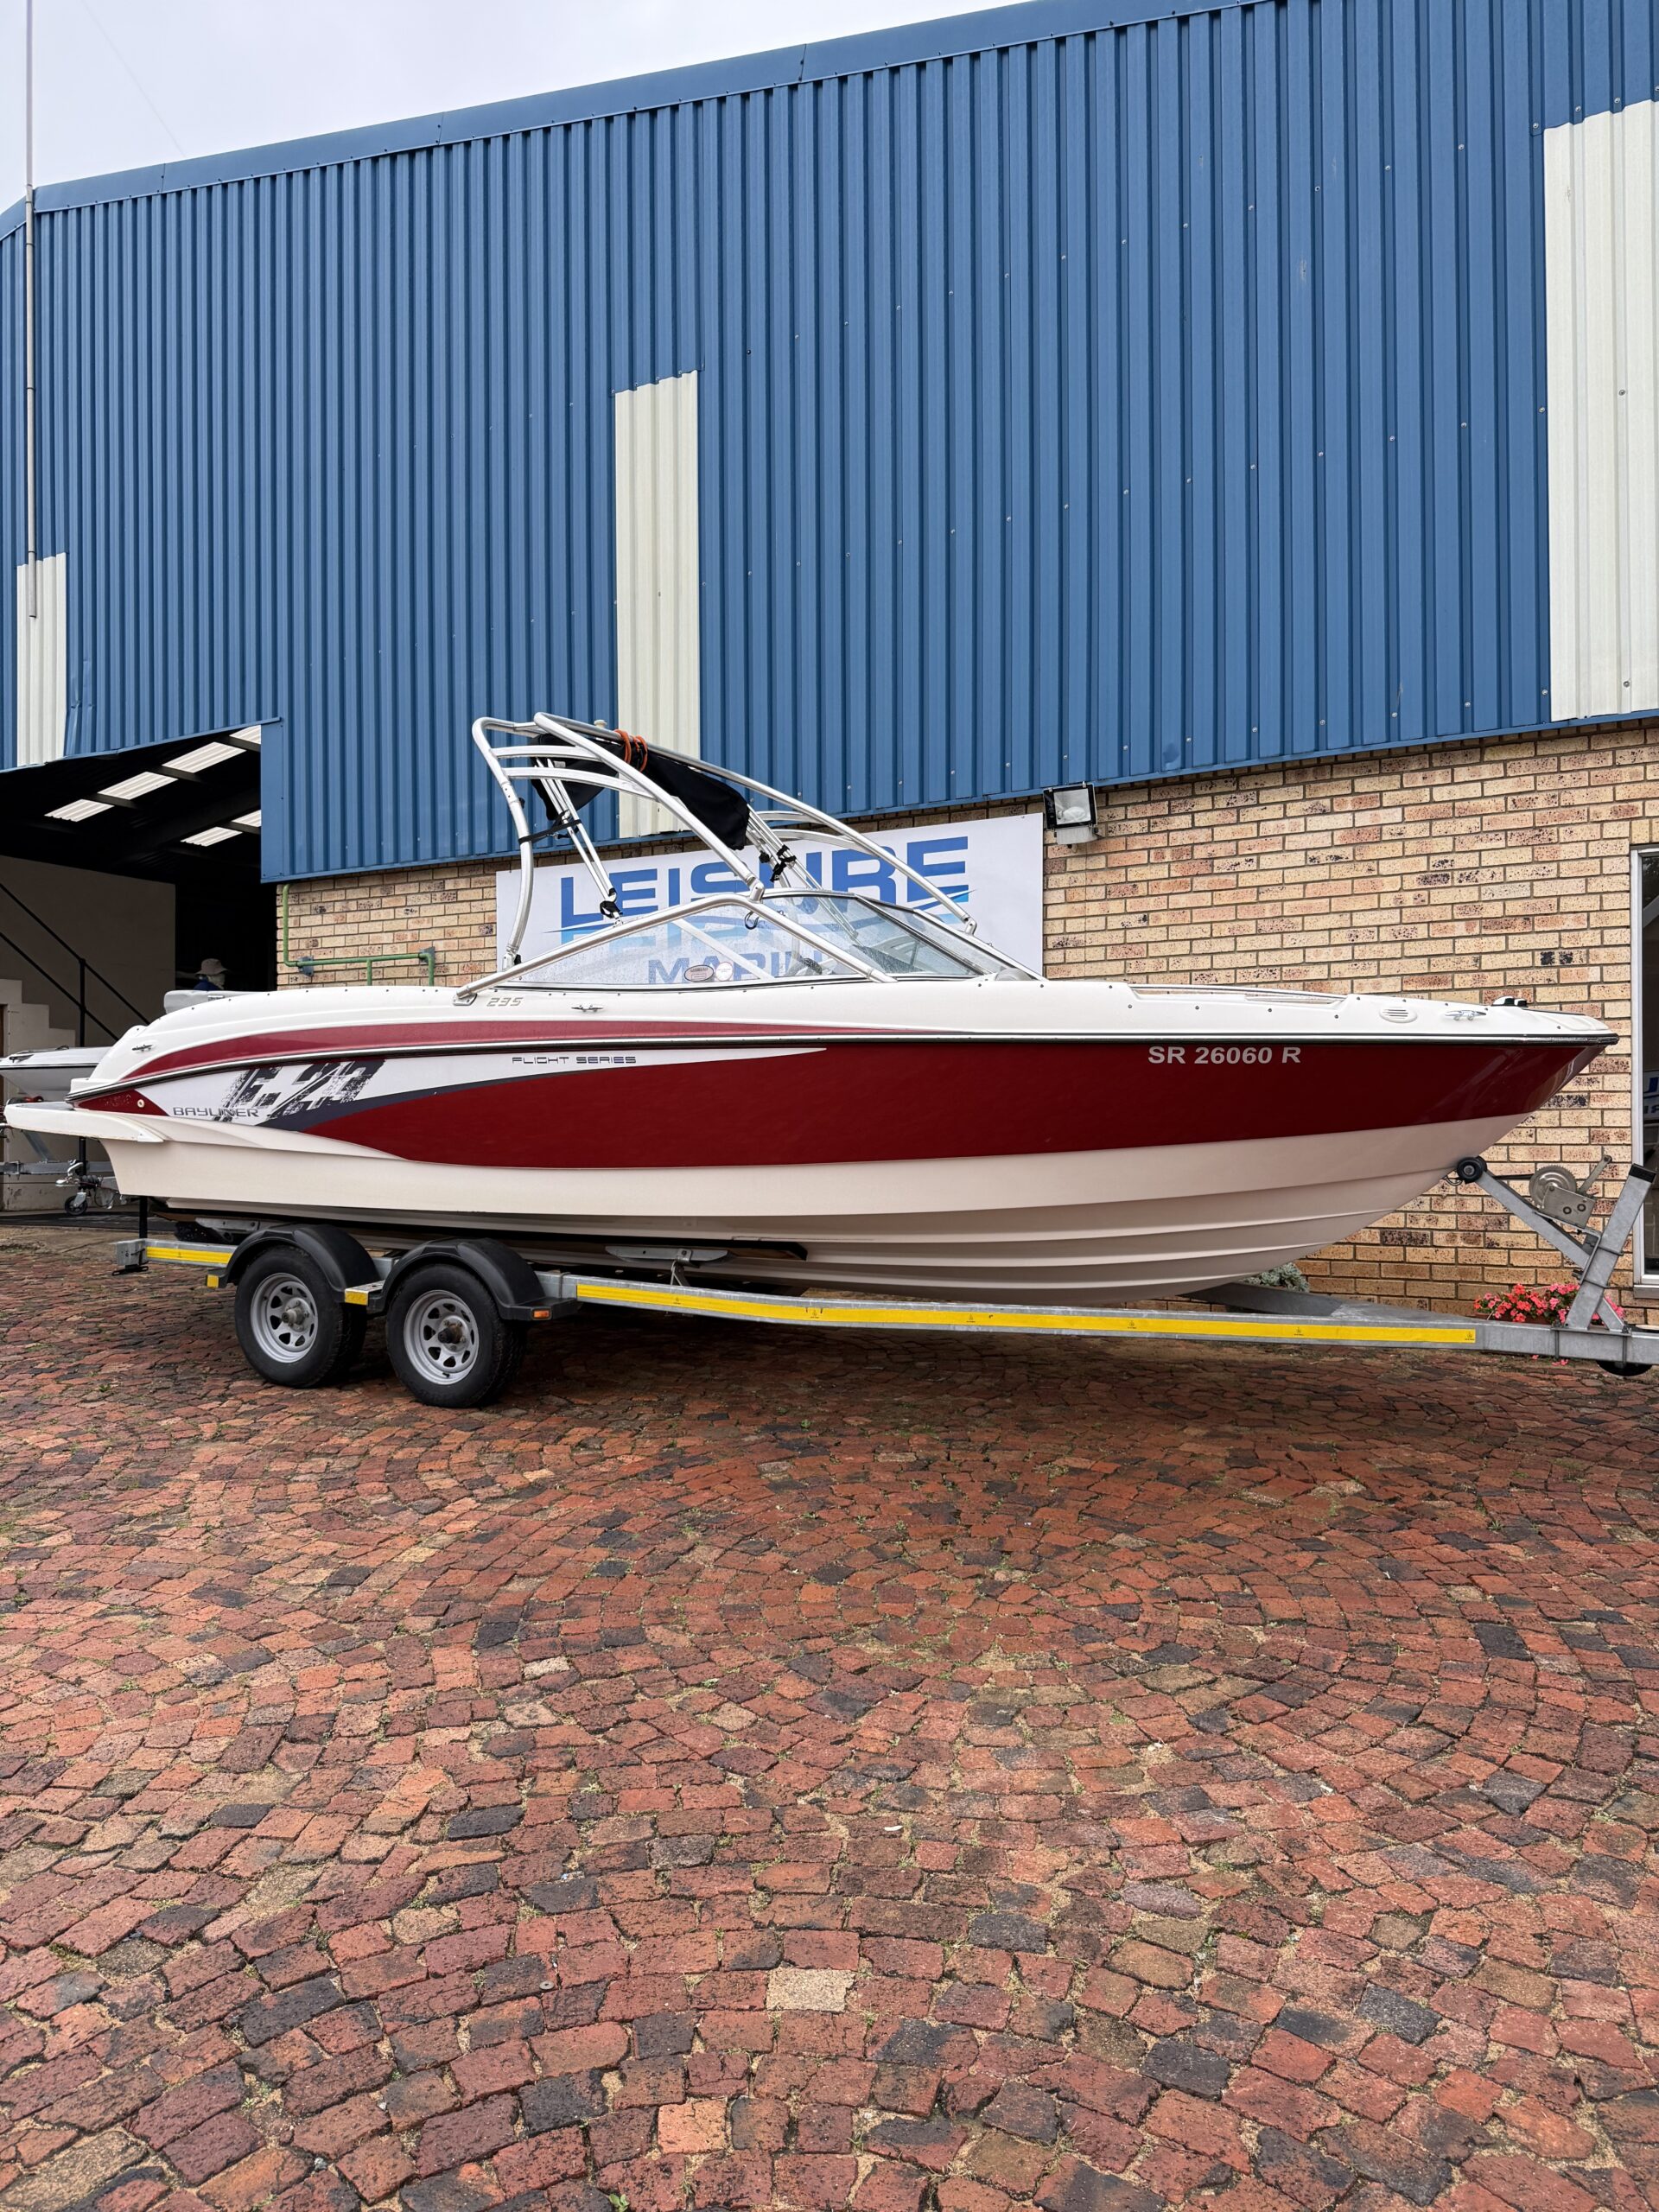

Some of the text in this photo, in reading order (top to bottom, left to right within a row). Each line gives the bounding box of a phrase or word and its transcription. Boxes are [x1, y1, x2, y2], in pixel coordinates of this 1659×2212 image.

[486, 996, 524, 1007] 235
[512, 1056, 637, 1065] FLIGHT SERIES
[1147, 1046, 1301, 1065] SR 26060 R
[173, 1106, 260, 1117] BAYLINER
